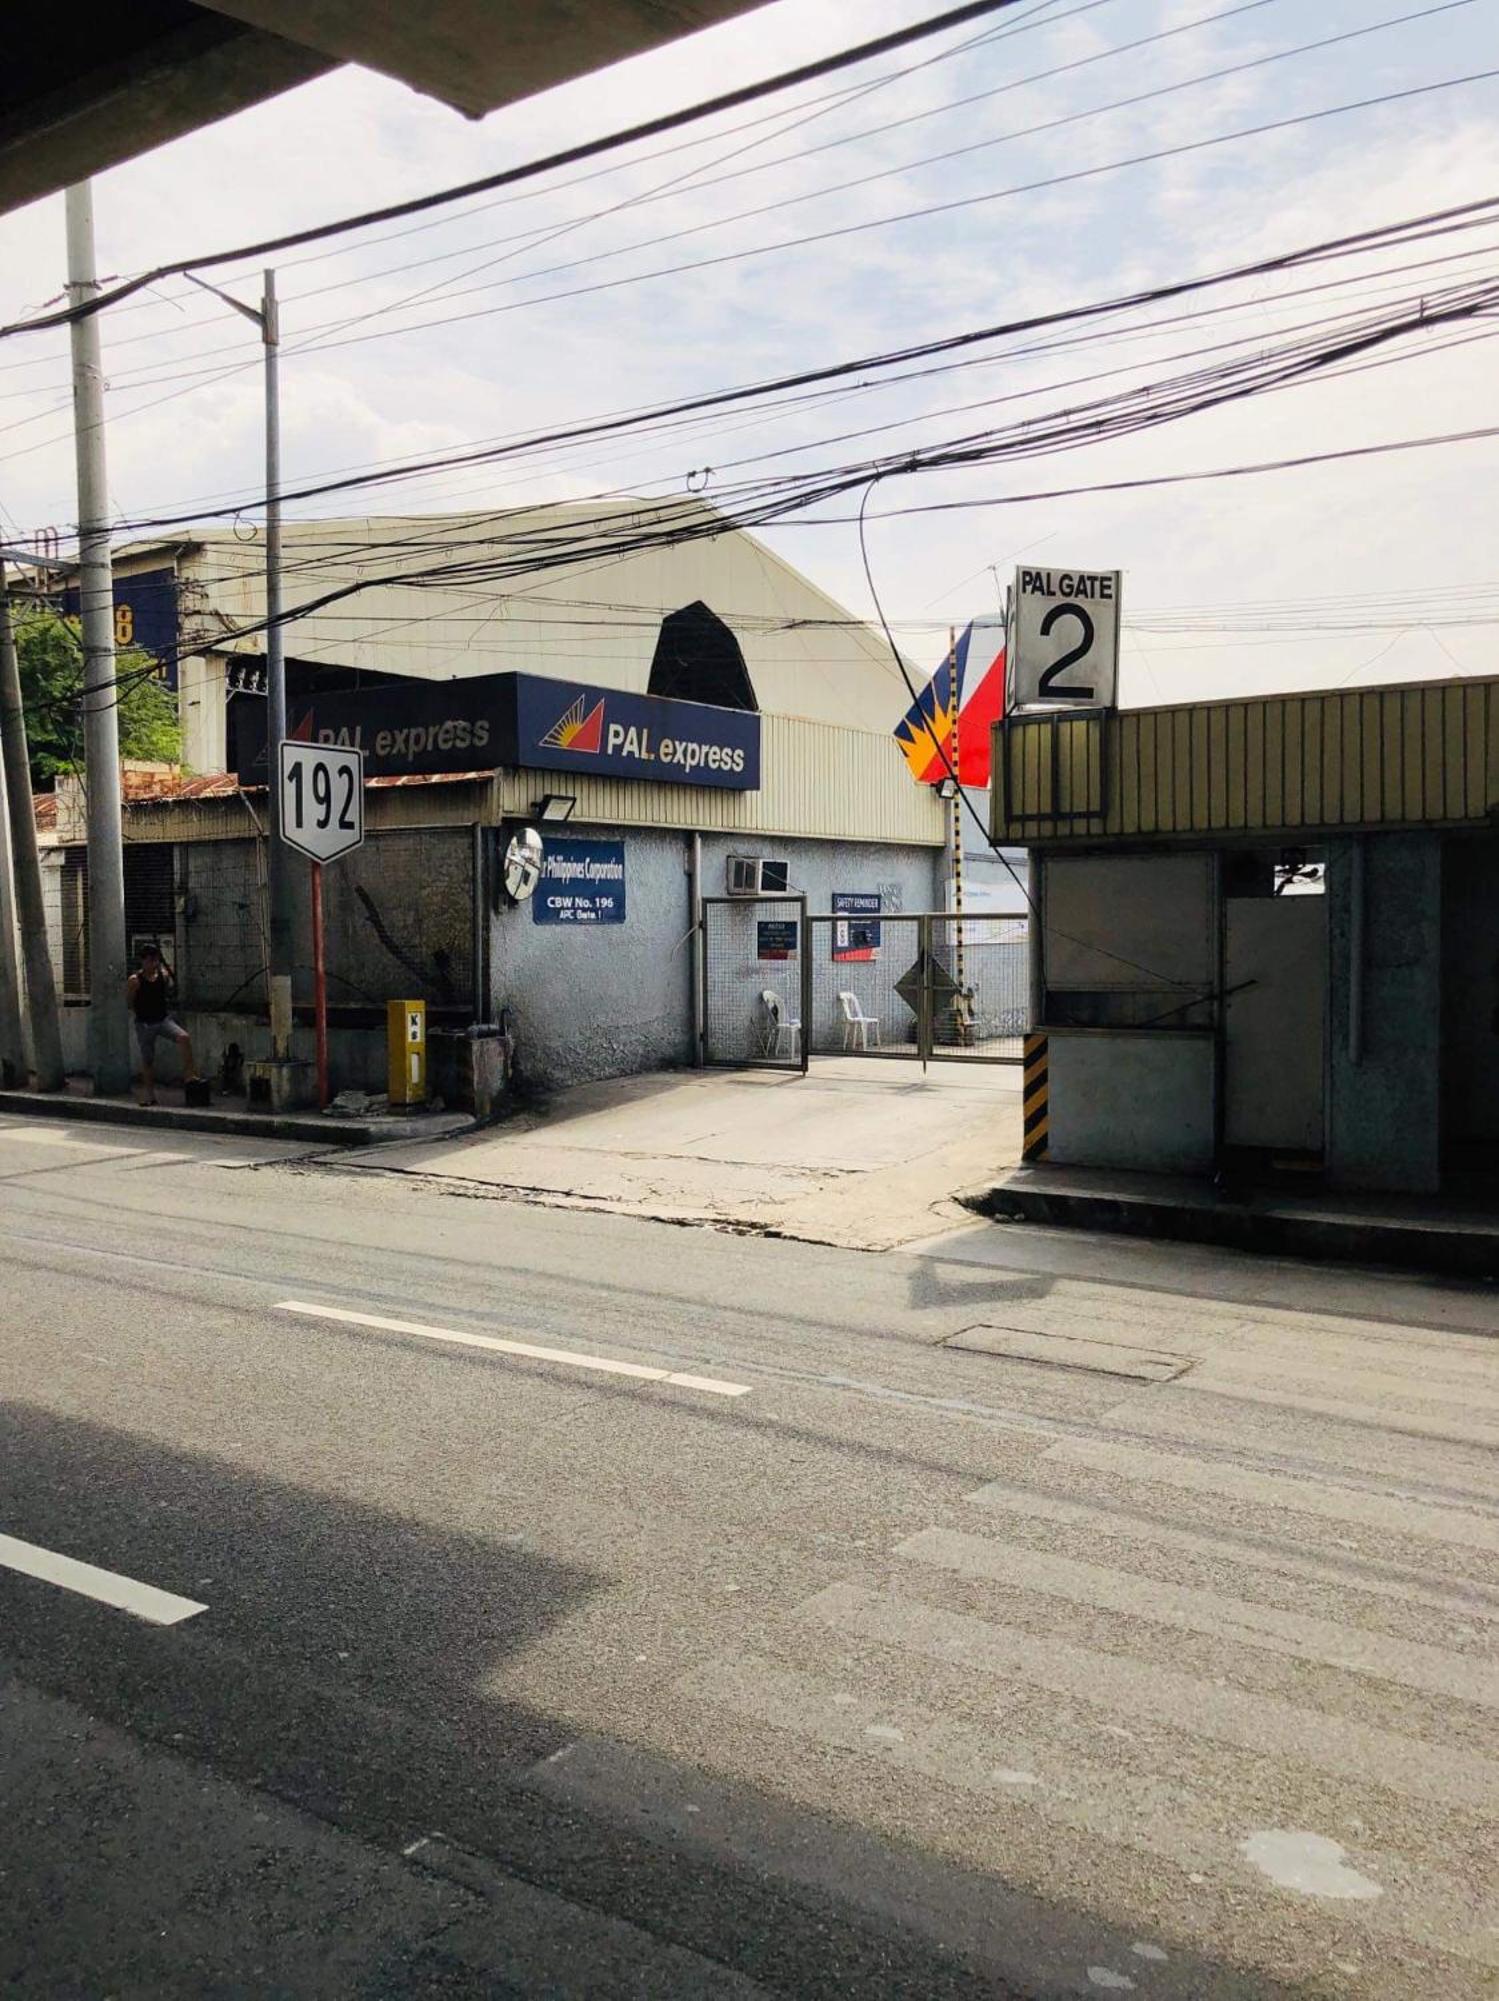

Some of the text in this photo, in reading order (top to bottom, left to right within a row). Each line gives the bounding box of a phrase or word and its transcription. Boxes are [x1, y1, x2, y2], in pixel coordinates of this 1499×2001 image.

[1022, 570, 1113, 600] PAL GATE
[1038, 602, 1095, 699] 2
[375, 720, 490, 762] express
[606, 722, 745, 773] PAL express
[287, 761, 356, 831] 192
[547, 896, 573, 908] CBW
[574, 897, 593, 908] No.
